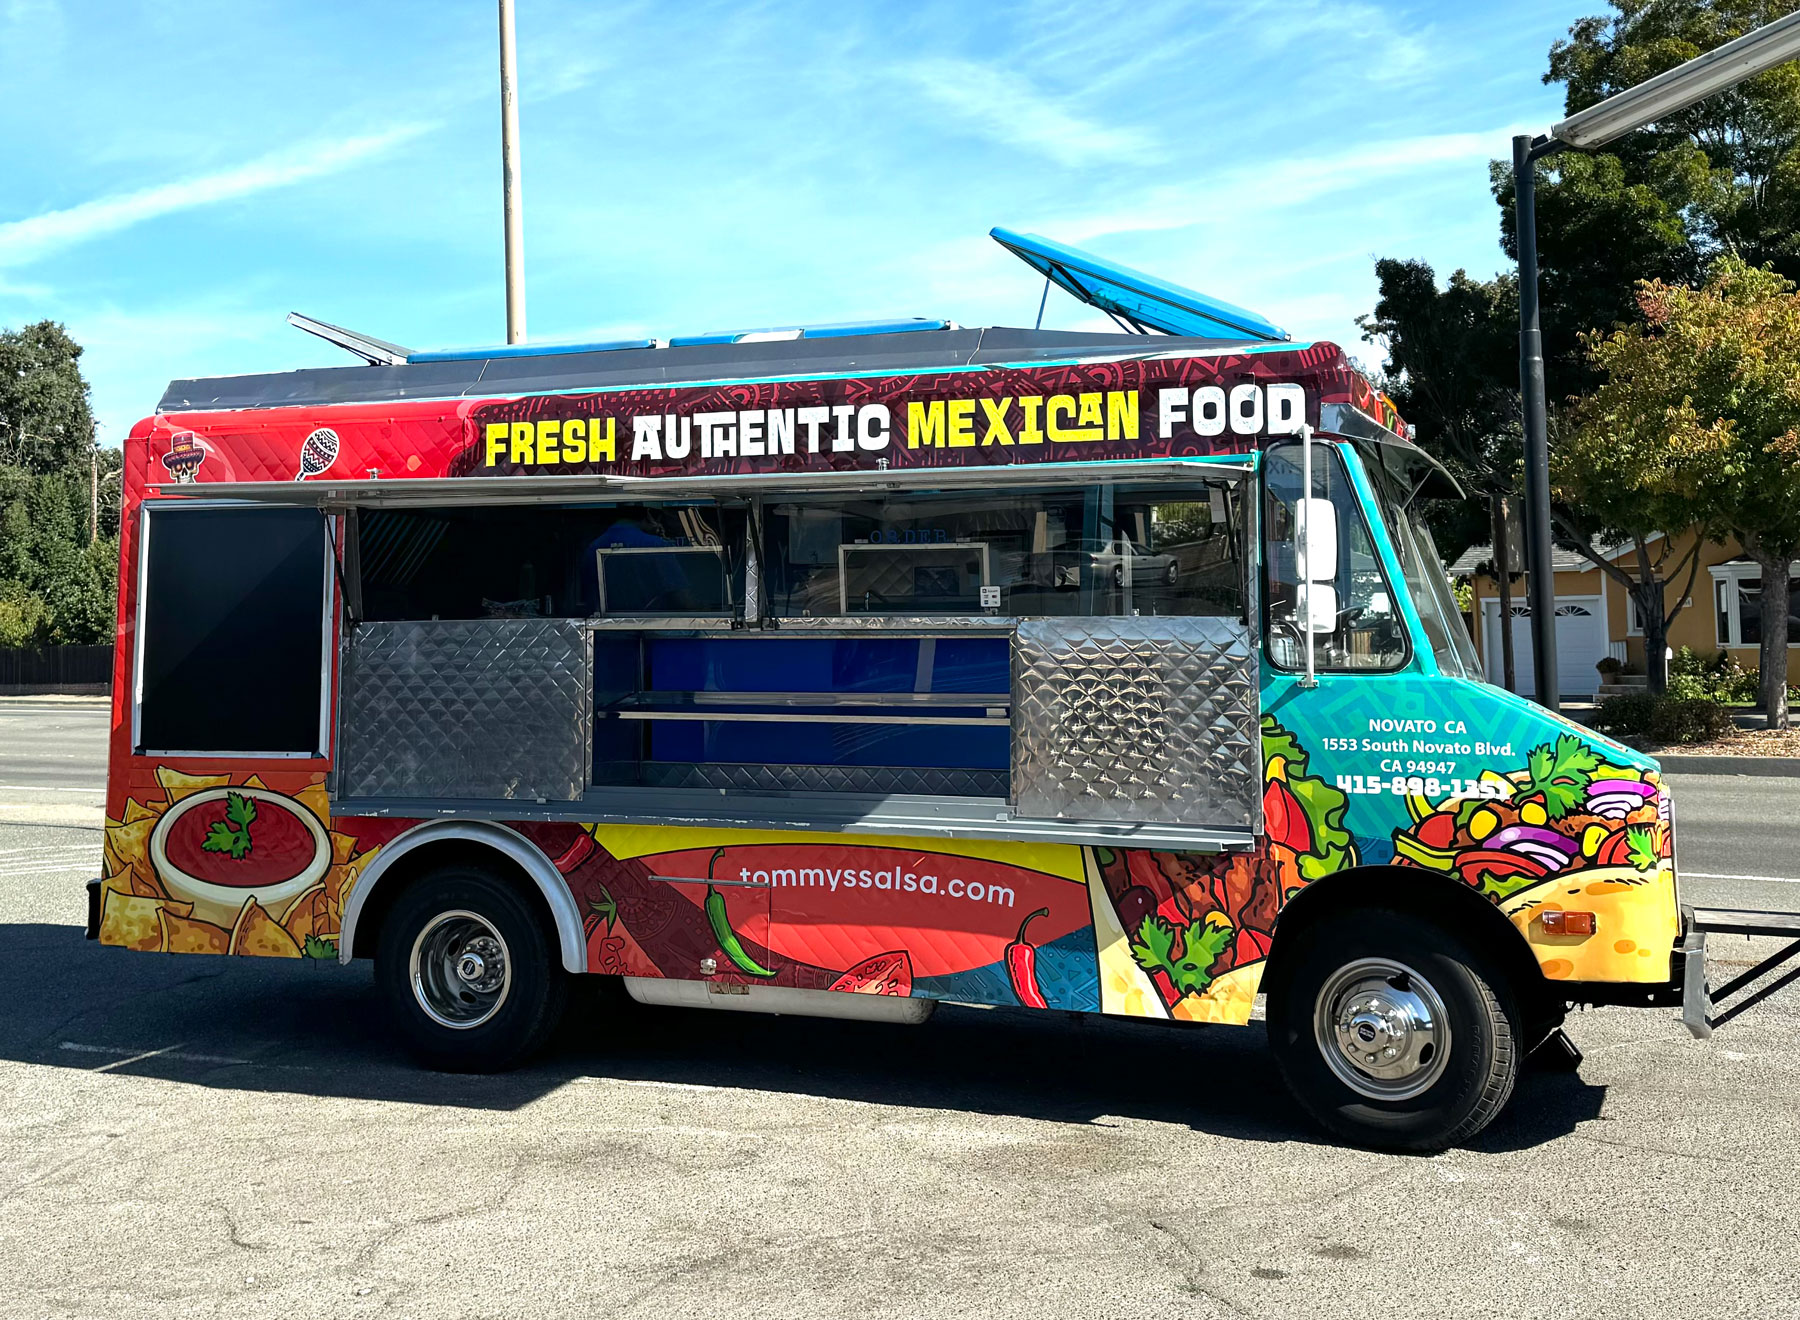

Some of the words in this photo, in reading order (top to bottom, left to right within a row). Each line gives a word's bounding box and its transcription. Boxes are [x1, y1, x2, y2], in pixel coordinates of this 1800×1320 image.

[485, 417, 616, 467] FRESH
[631, 403, 891, 461] AUTHENTIC
[907, 390, 1139, 450] MEXICAN
[1158, 383, 1306, 439] FOOD
[870, 528, 949, 544] ORDER
[1369, 719, 1437, 734] NOVATO
[1444, 720, 1467, 735] CA
[1322, 737, 1357, 751] 1553
[1361, 738, 1408, 753] South
[1412, 740, 1471, 755] Novato
[1475, 741, 1516, 757] Blvd.
[1380, 759, 1403, 773] CA
[1406, 760, 1456, 775] 94947
[1336, 775, 1510, 799] 415-898-1351
[739, 866, 1015, 908] tommyssalsa.com
